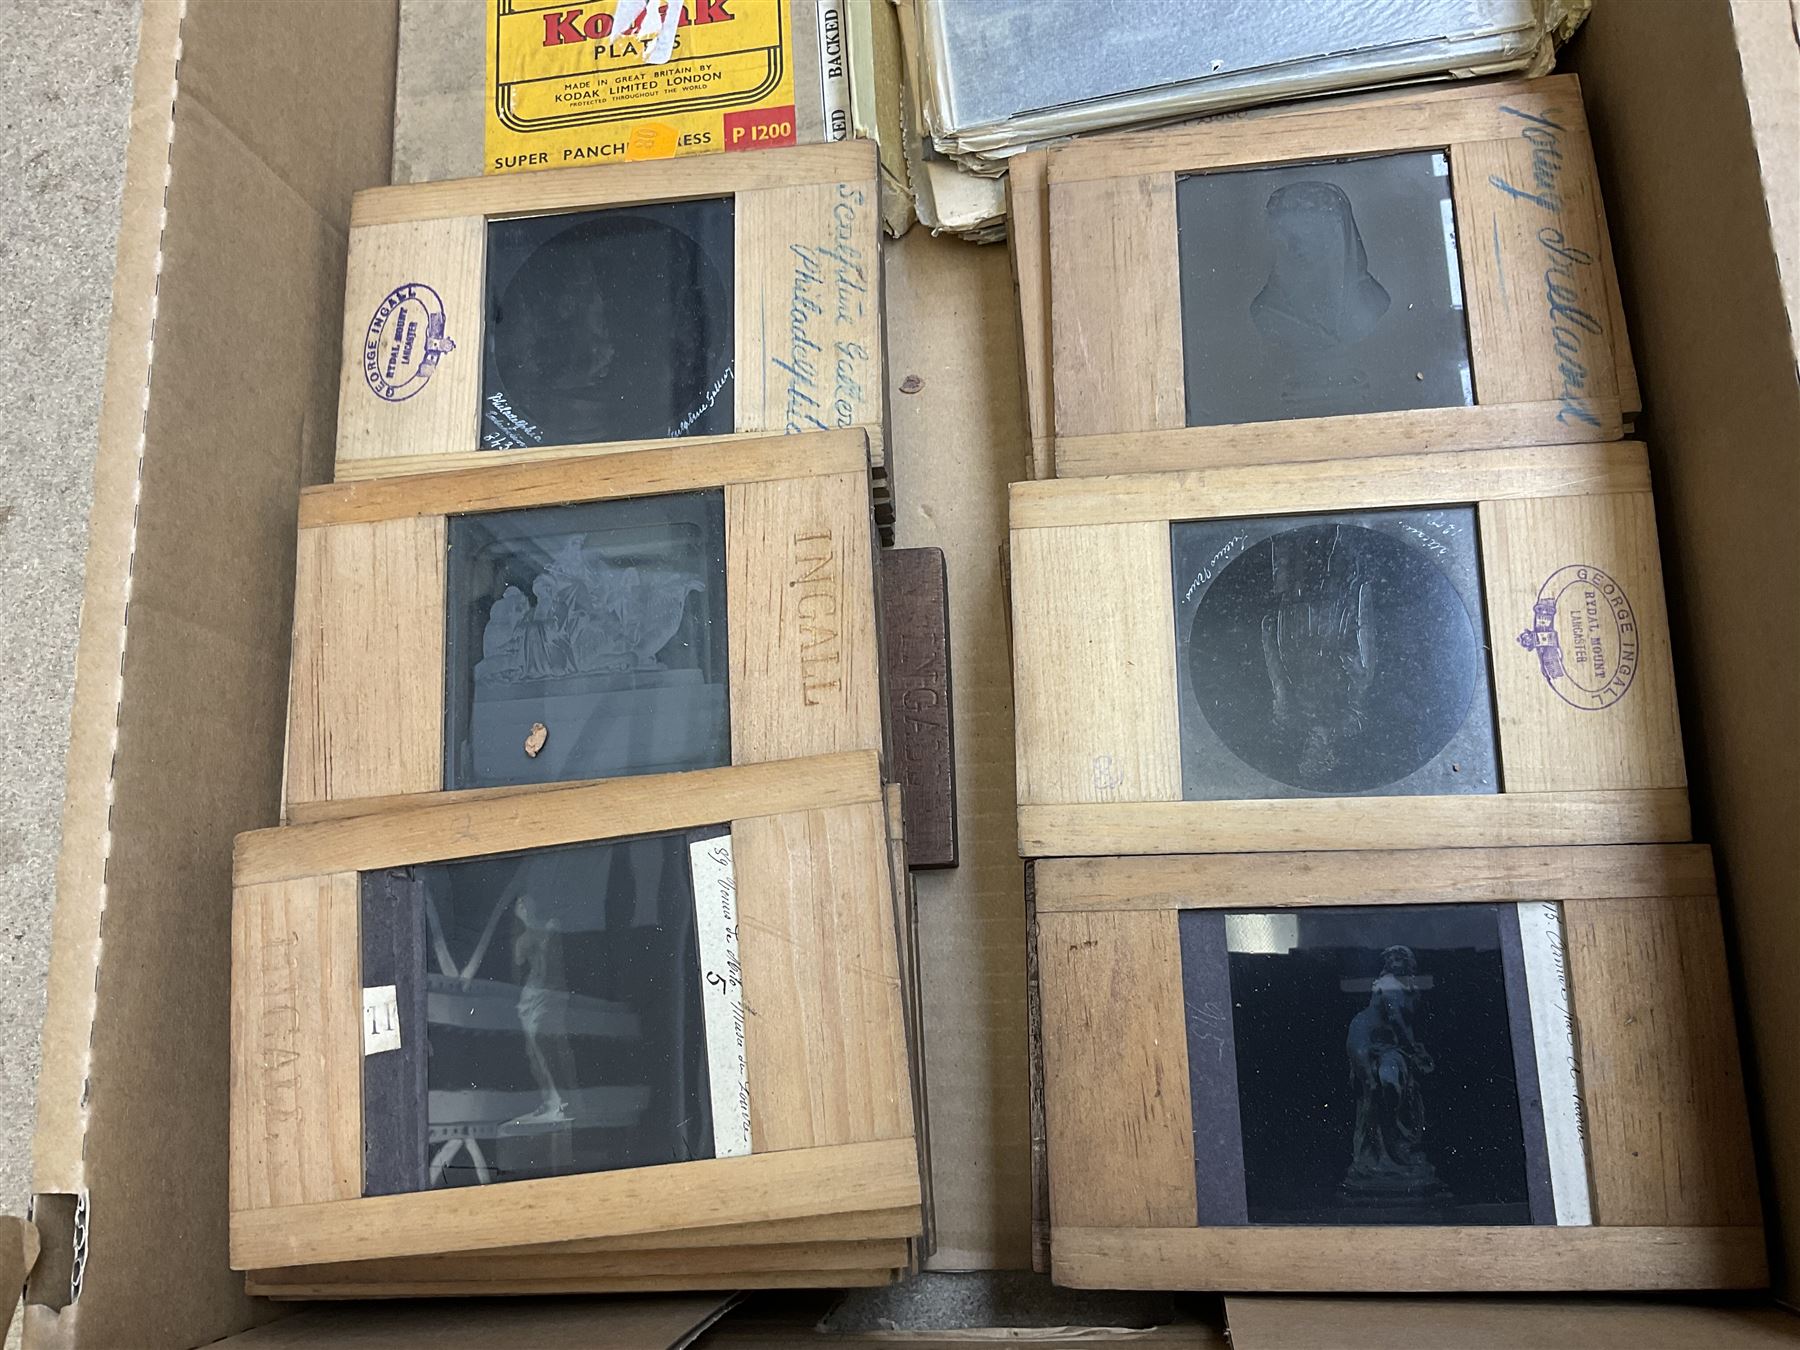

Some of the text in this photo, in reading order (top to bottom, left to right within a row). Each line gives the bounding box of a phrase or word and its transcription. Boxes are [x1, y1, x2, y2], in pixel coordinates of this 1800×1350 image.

[594, 34, 681, 60] PLATS
[824, 9, 843, 79] BACKED
[555, 71, 722, 103] KODAK LIMITED LONDON
[564, 64, 712, 91] MADE IN GREAT BRITAIN BY
[569, 98, 607, 107] PROTECTED
[612, 91, 659, 102] THROUGHOUT
[495, 152, 549, 169] SUPER
[563, 142, 630, 161] PANCH
[732, 121, 792, 143] P 1200
[1489, 105, 1567, 216] Young
[366, 286, 417, 398] GEORGE INGALL
[834, 340, 869, 430] Galler
[794, 528, 843, 707] INGALL
[1570, 610, 1588, 664] LANCASTER
[1577, 568, 1636, 706] GEORGE INGALL
[1584, 590, 1606, 679] RYDAL MOUNT
[717, 876, 737, 920] Venus
[706, 971, 727, 996] 5
